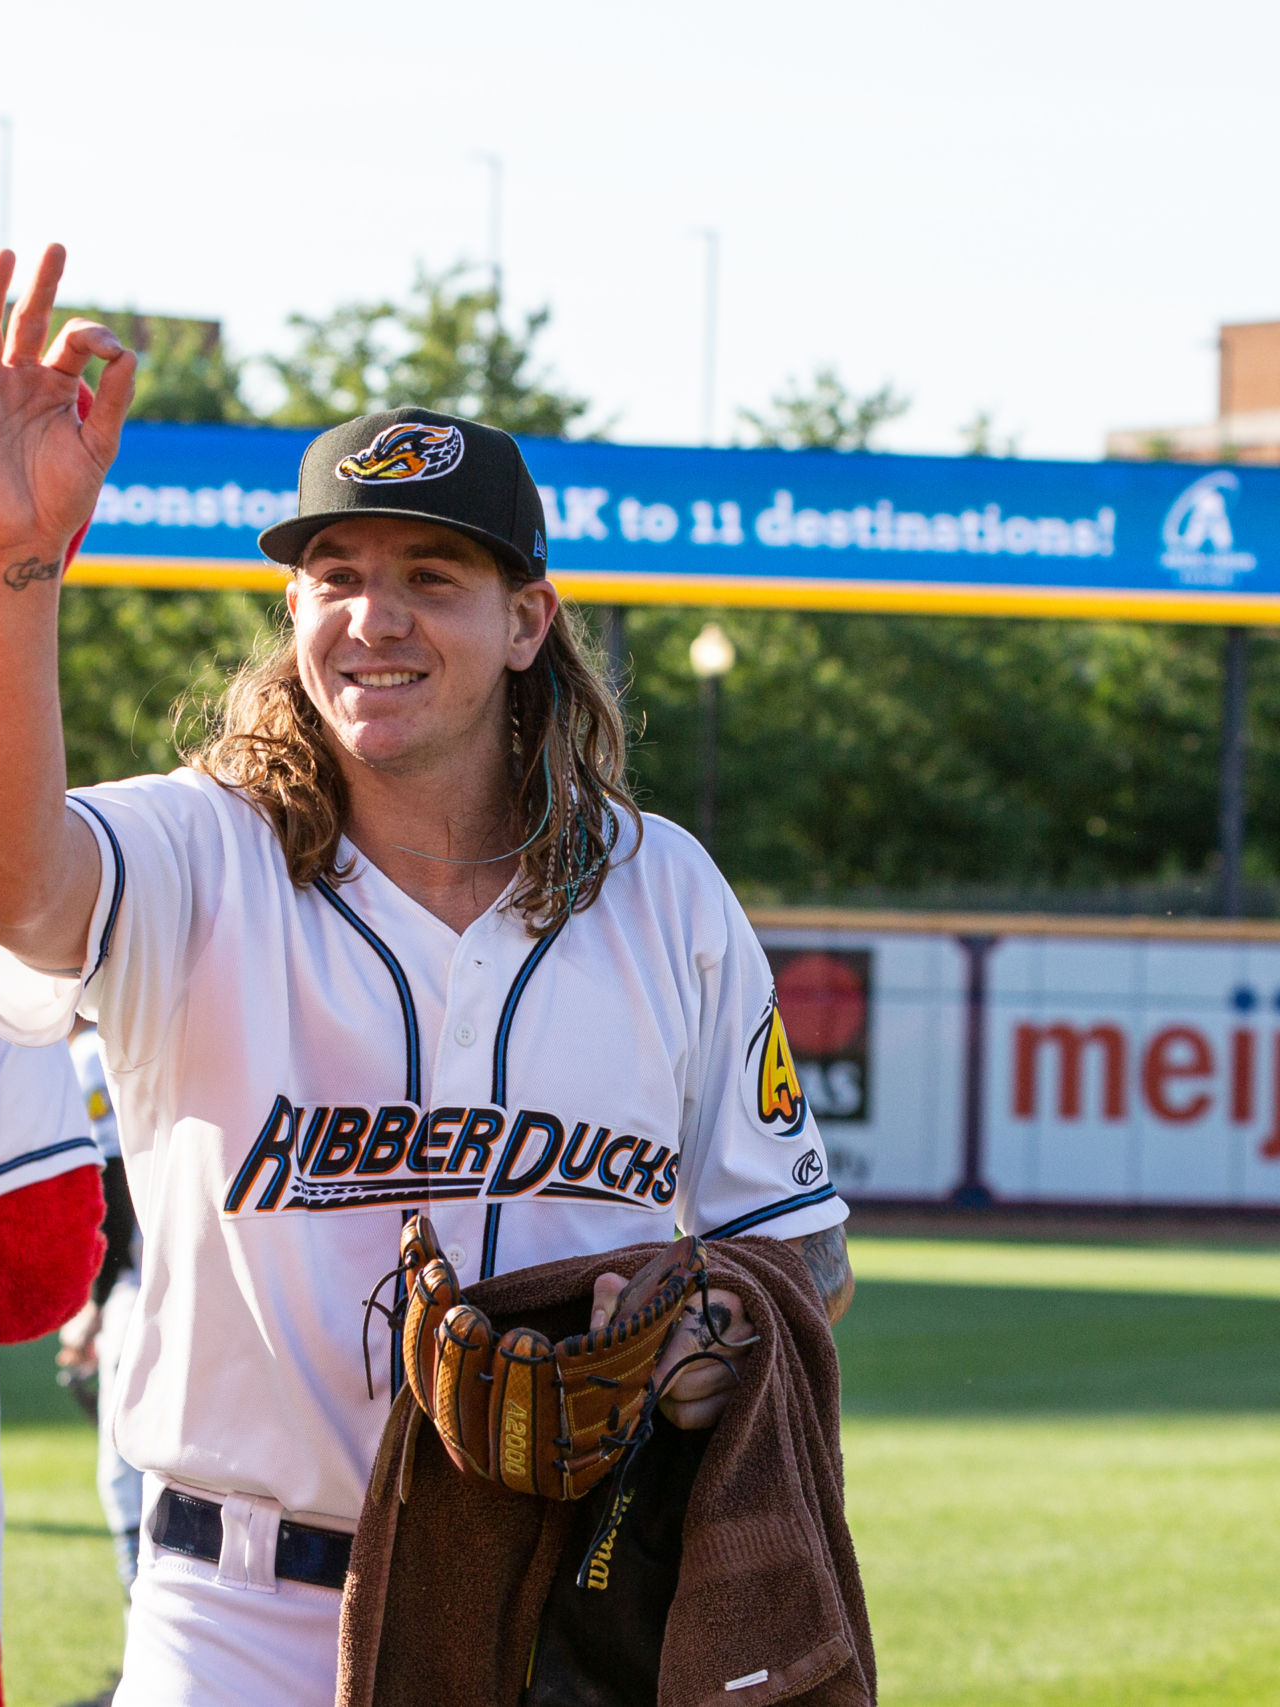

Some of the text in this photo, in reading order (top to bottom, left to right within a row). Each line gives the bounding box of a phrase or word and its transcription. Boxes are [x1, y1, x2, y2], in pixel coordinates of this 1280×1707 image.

[619, 496, 678, 542] to
[690, 500, 744, 545] 11
[754, 488, 1116, 558] destinations!
[505, 1400, 528, 1478] A2000
